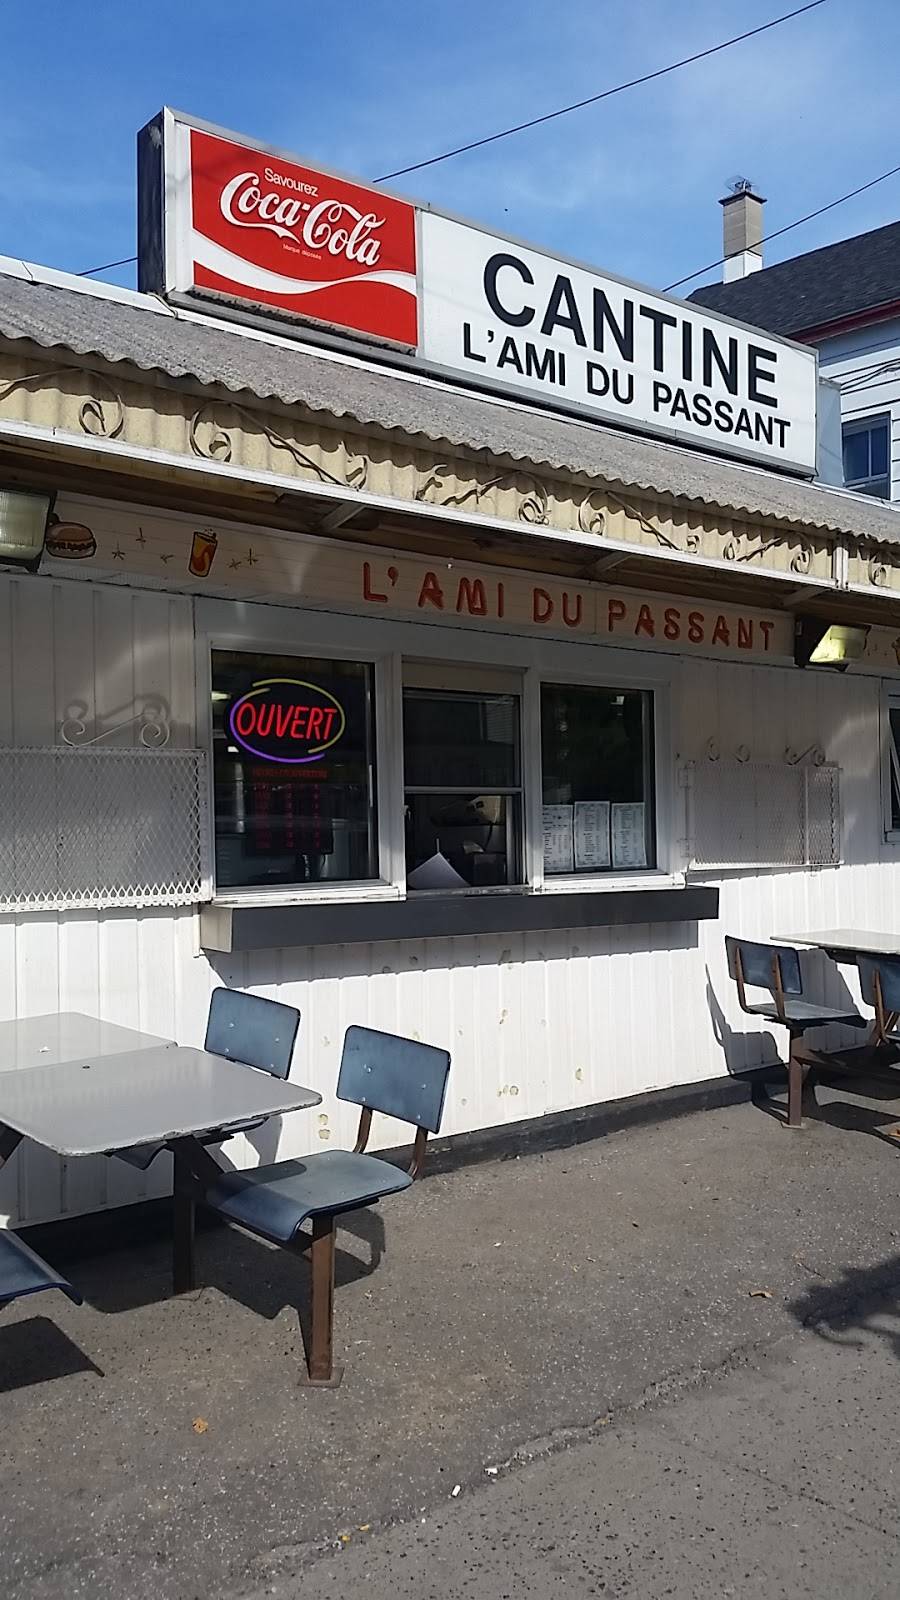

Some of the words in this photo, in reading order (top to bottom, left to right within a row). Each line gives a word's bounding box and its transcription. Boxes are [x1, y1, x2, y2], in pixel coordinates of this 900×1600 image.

[220, 172, 386, 266] Coca-Cola
[264, 168, 319, 197] Savourez
[484, 253, 778, 408] CANTINE
[463, 323, 566, 386] L'AMI
[587, 361, 634, 405] DU
[653, 381, 791, 448] PASSANT
[533, 588, 583, 628] DU
[608, 599, 775, 651] PASSANT
[236, 702, 338, 740] OUVERT
